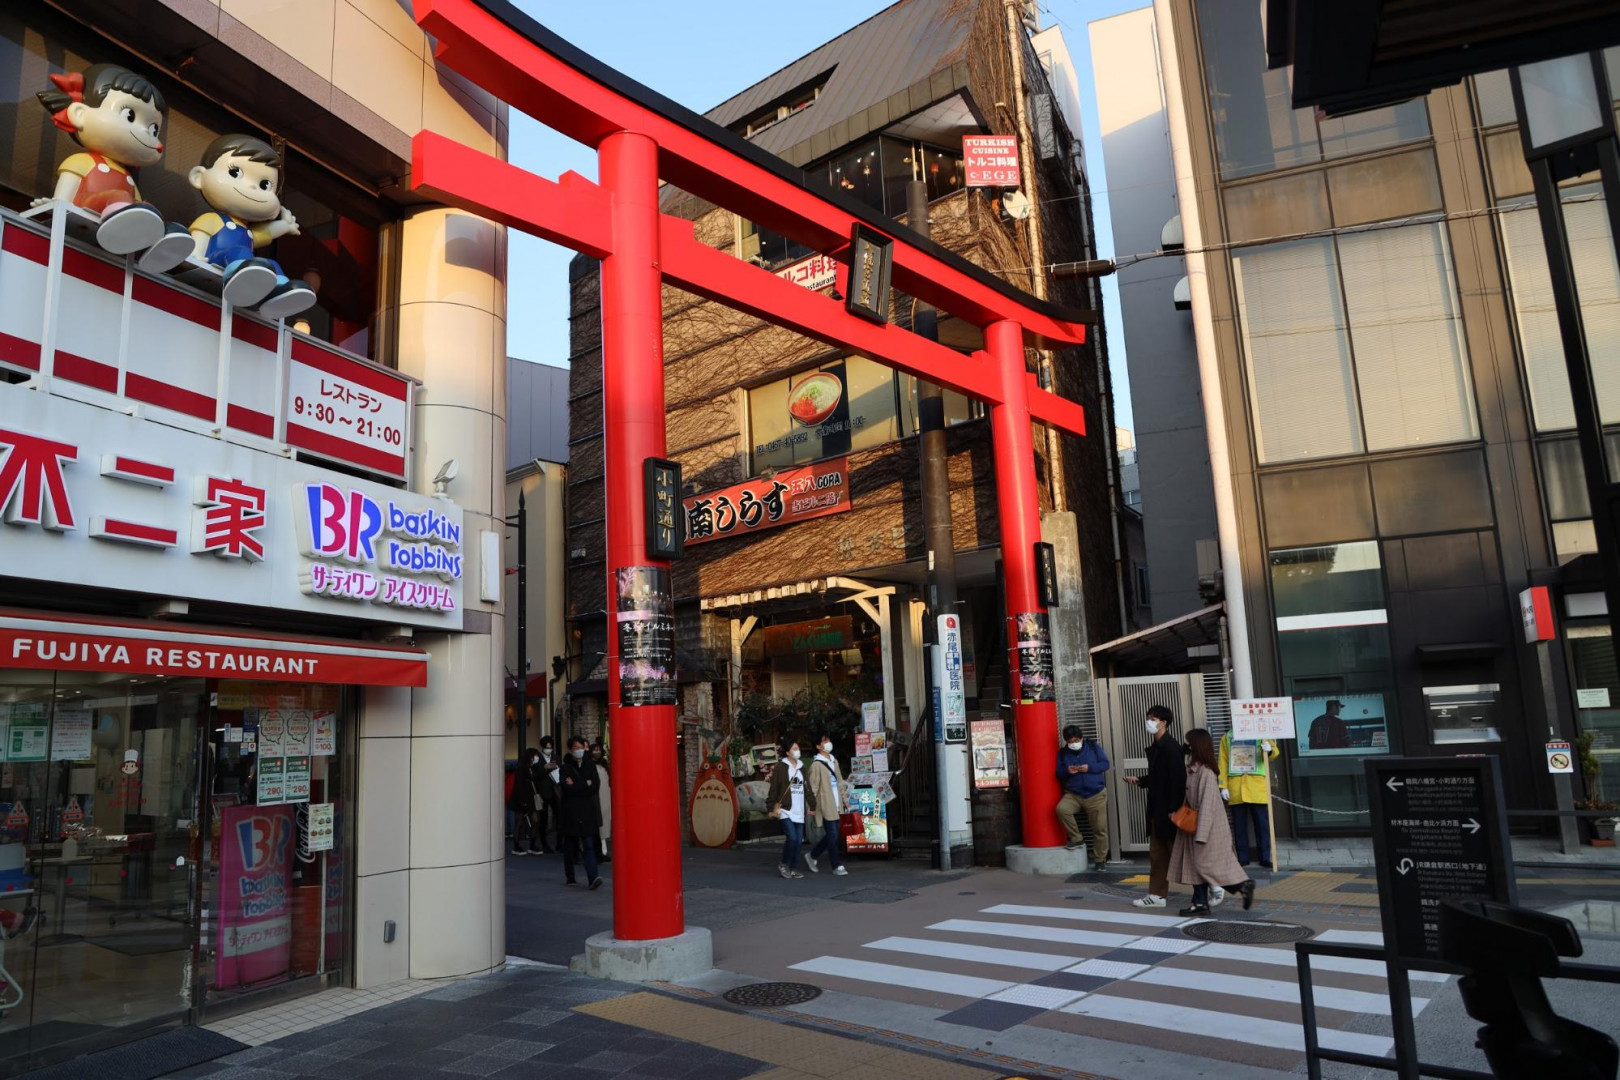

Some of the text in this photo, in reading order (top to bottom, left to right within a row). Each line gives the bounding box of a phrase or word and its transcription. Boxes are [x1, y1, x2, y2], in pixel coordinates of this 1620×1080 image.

[965, 138, 1015, 147] TURKISH
[968, 156, 1017, 167] トルコ料理
[982, 170, 1017, 180] EGE
[321, 378, 382, 414] レストラン
[0, 429, 267, 561] 不二家
[791, 478, 816, 495] 五八
[305, 481, 385, 562] BR
[388, 501, 461, 545] baskin
[656, 469, 676, 548] 小町通り
[683, 481, 791, 541] 南しらす
[389, 541, 463, 580] robbins
[312, 565, 456, 611] サーティワン アイスクリーム
[12, 637, 319, 675] FUJIYA RESTAURANT
